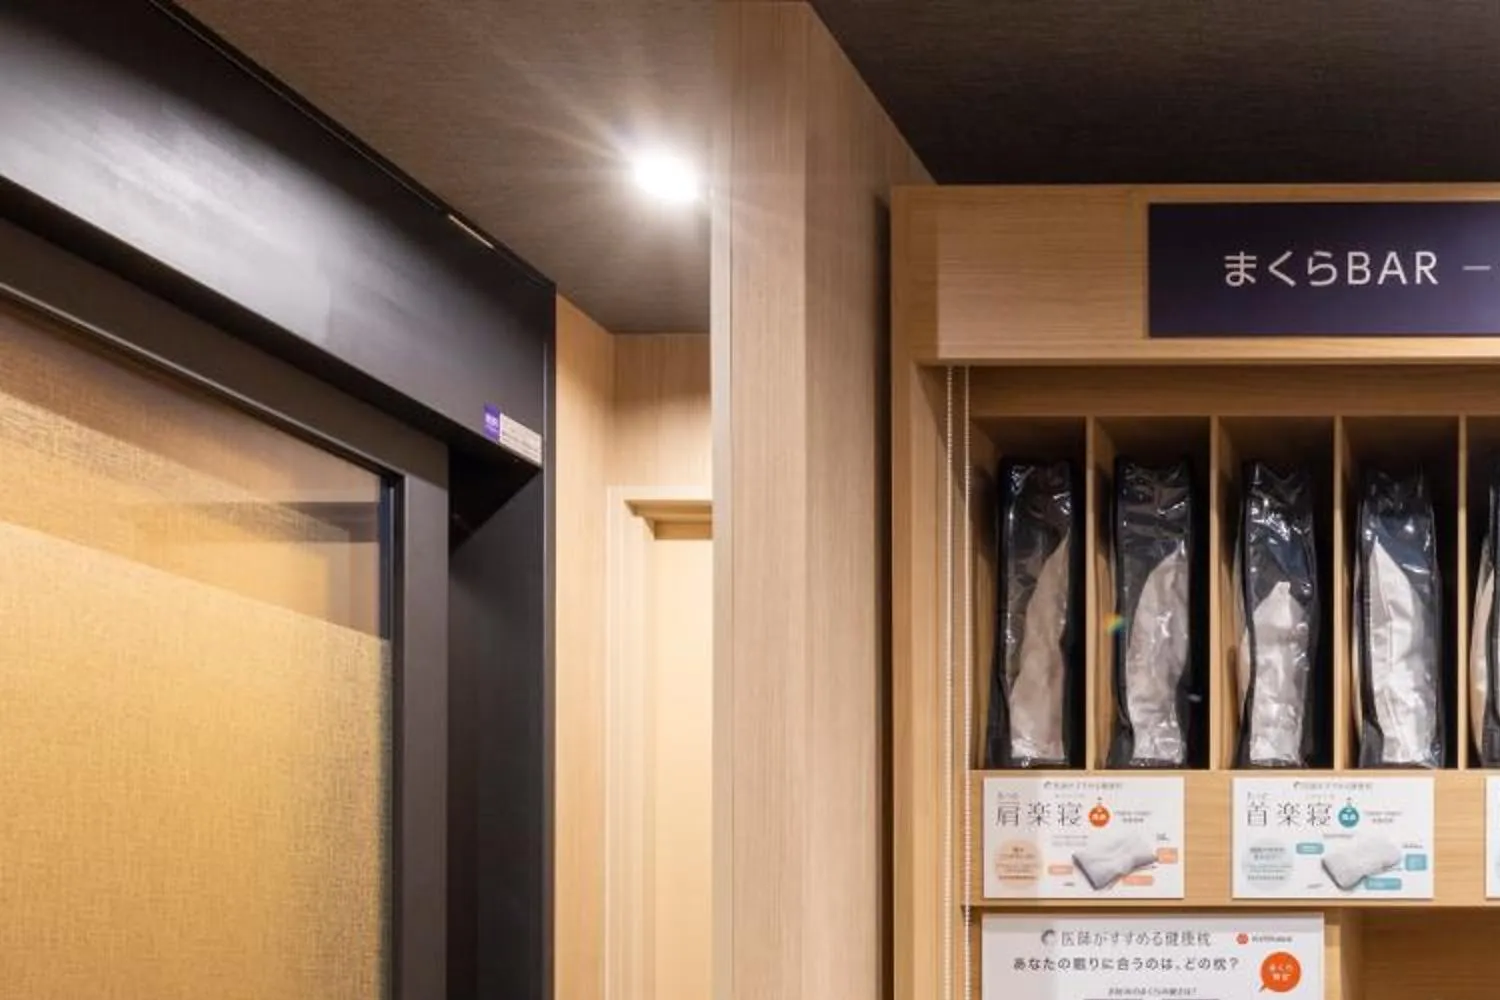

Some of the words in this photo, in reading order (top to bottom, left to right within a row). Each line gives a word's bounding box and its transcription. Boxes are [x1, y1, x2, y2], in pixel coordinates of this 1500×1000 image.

[1223, 250, 1439, 287] まくらBAR
[1060, 930, 1211, 947] 医師がすすめる健康枕
